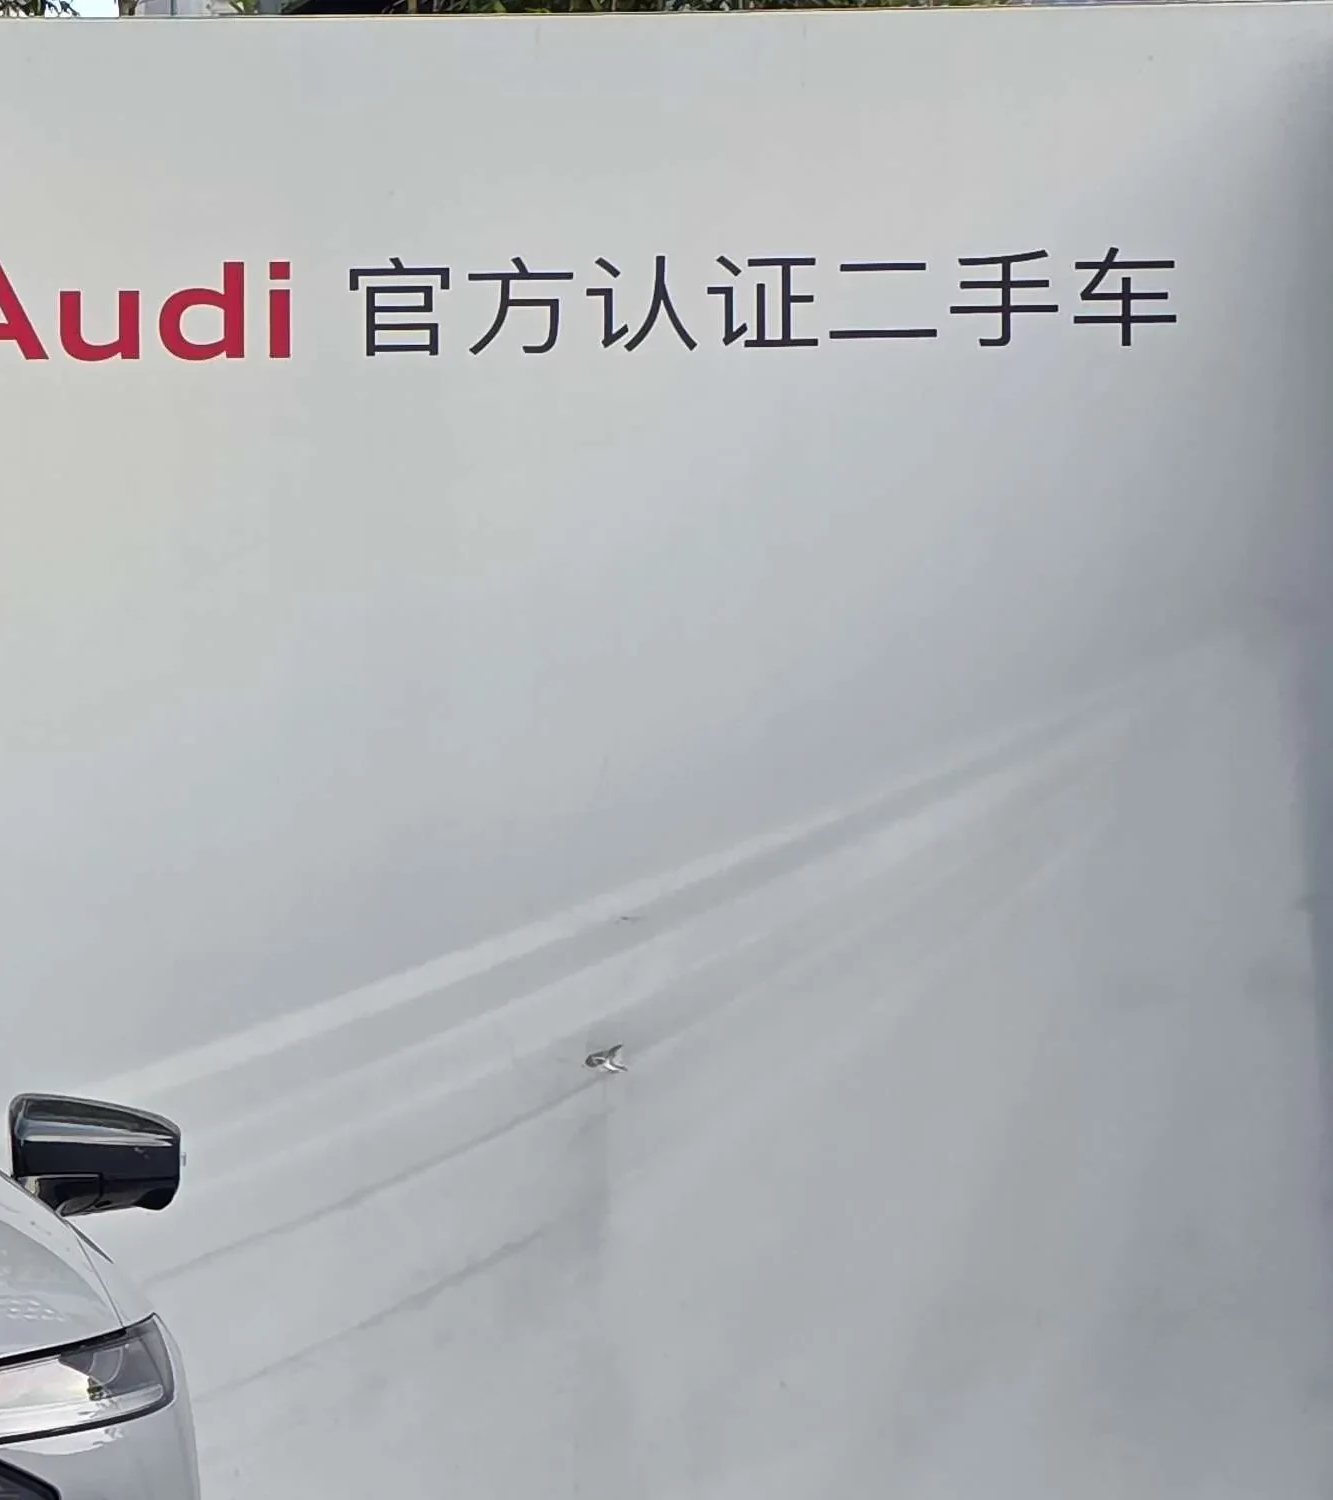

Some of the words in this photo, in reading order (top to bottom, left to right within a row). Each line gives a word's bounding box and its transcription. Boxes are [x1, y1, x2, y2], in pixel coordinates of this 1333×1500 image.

[349, 246, 1177, 357] 官方认证二手车
